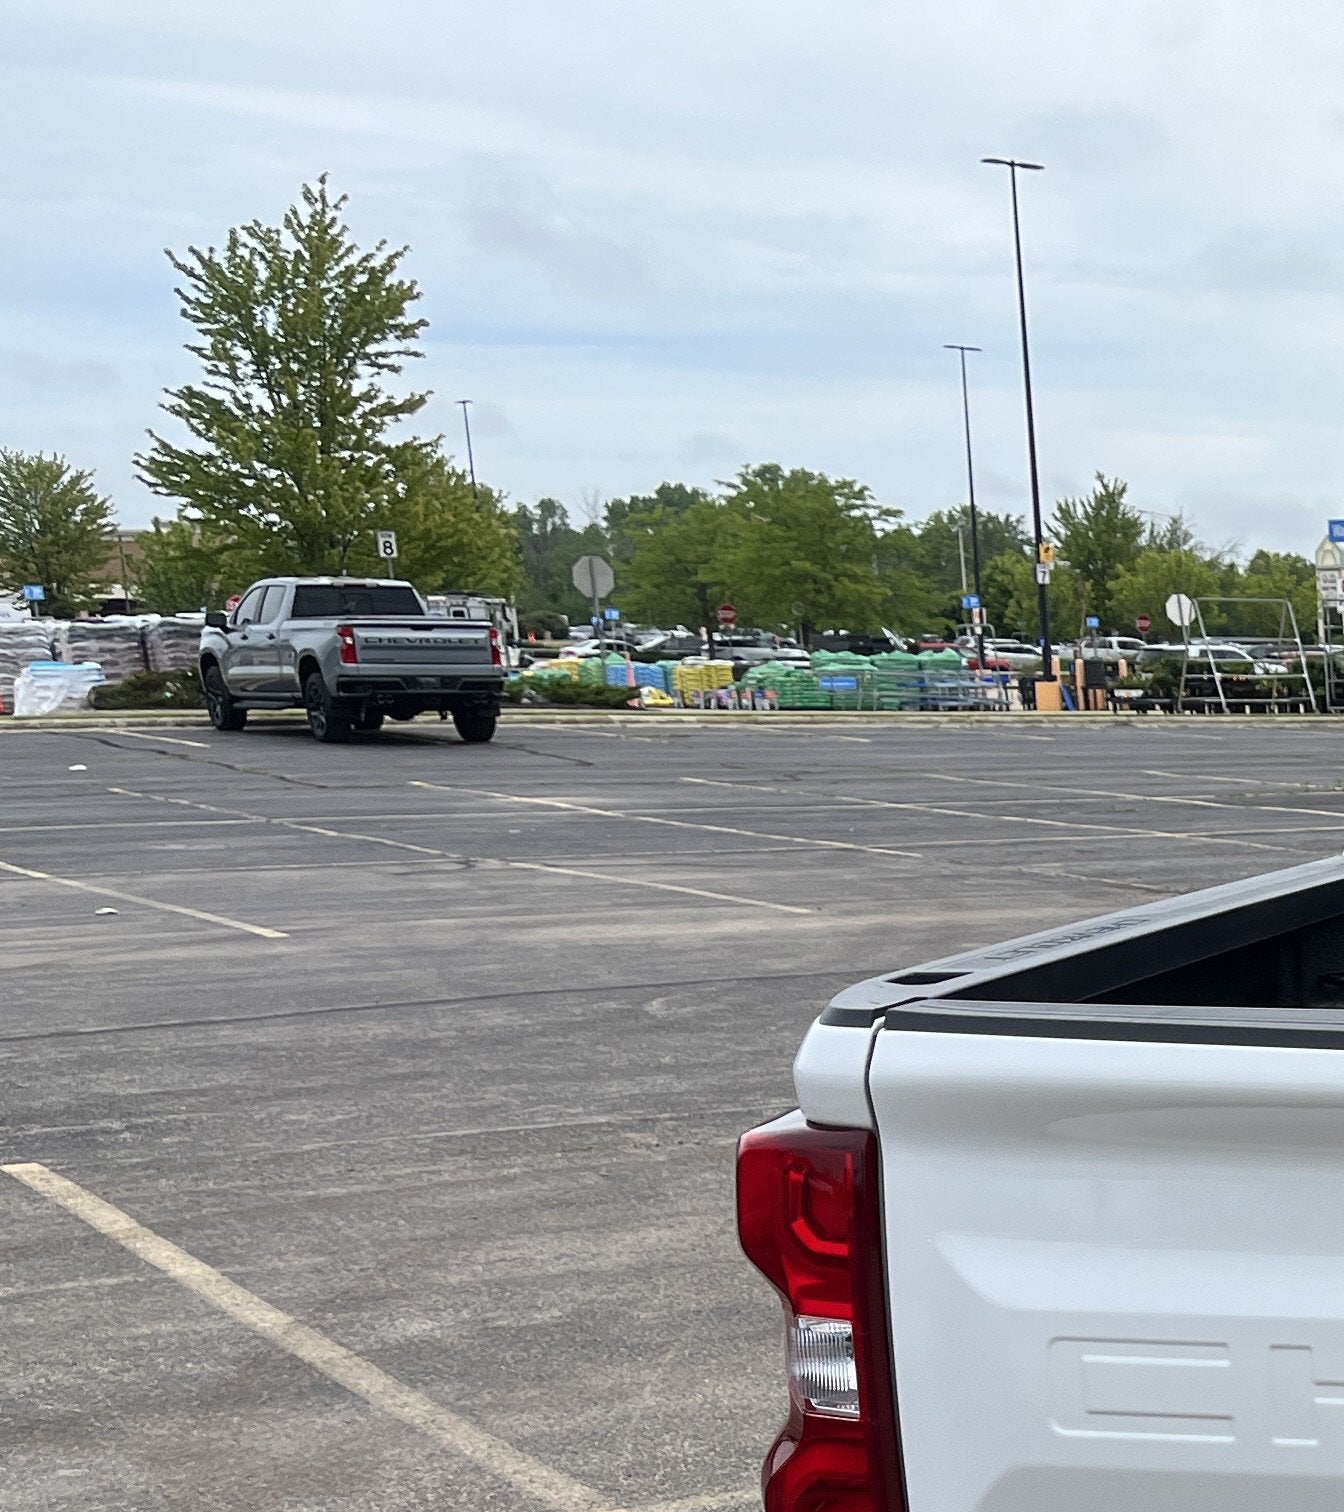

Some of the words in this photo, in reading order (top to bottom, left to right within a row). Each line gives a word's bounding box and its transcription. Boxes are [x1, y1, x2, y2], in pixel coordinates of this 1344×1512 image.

[383, 540, 394, 556] 8
[1040, 570, 1048, 583] 7
[364, 636, 481, 646] CHEVROLET
